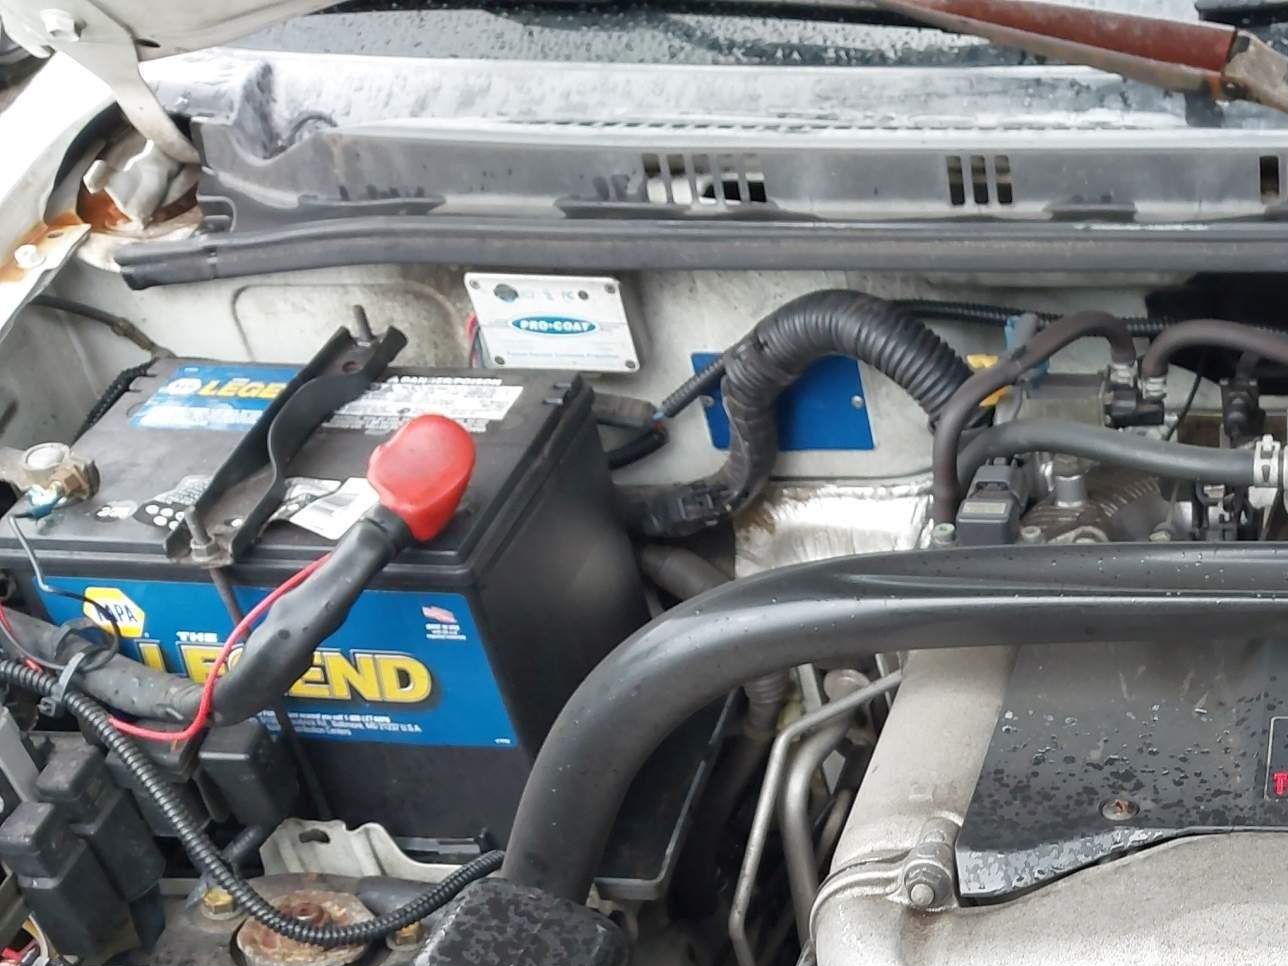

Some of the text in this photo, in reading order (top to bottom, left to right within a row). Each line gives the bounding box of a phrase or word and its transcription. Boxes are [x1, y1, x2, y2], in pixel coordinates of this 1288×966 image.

[199, 379, 288, 398] LEGE
[95, 603, 139, 624] NPA
[175, 631, 218, 643] THE
[136, 640, 434, 703] LEEND
